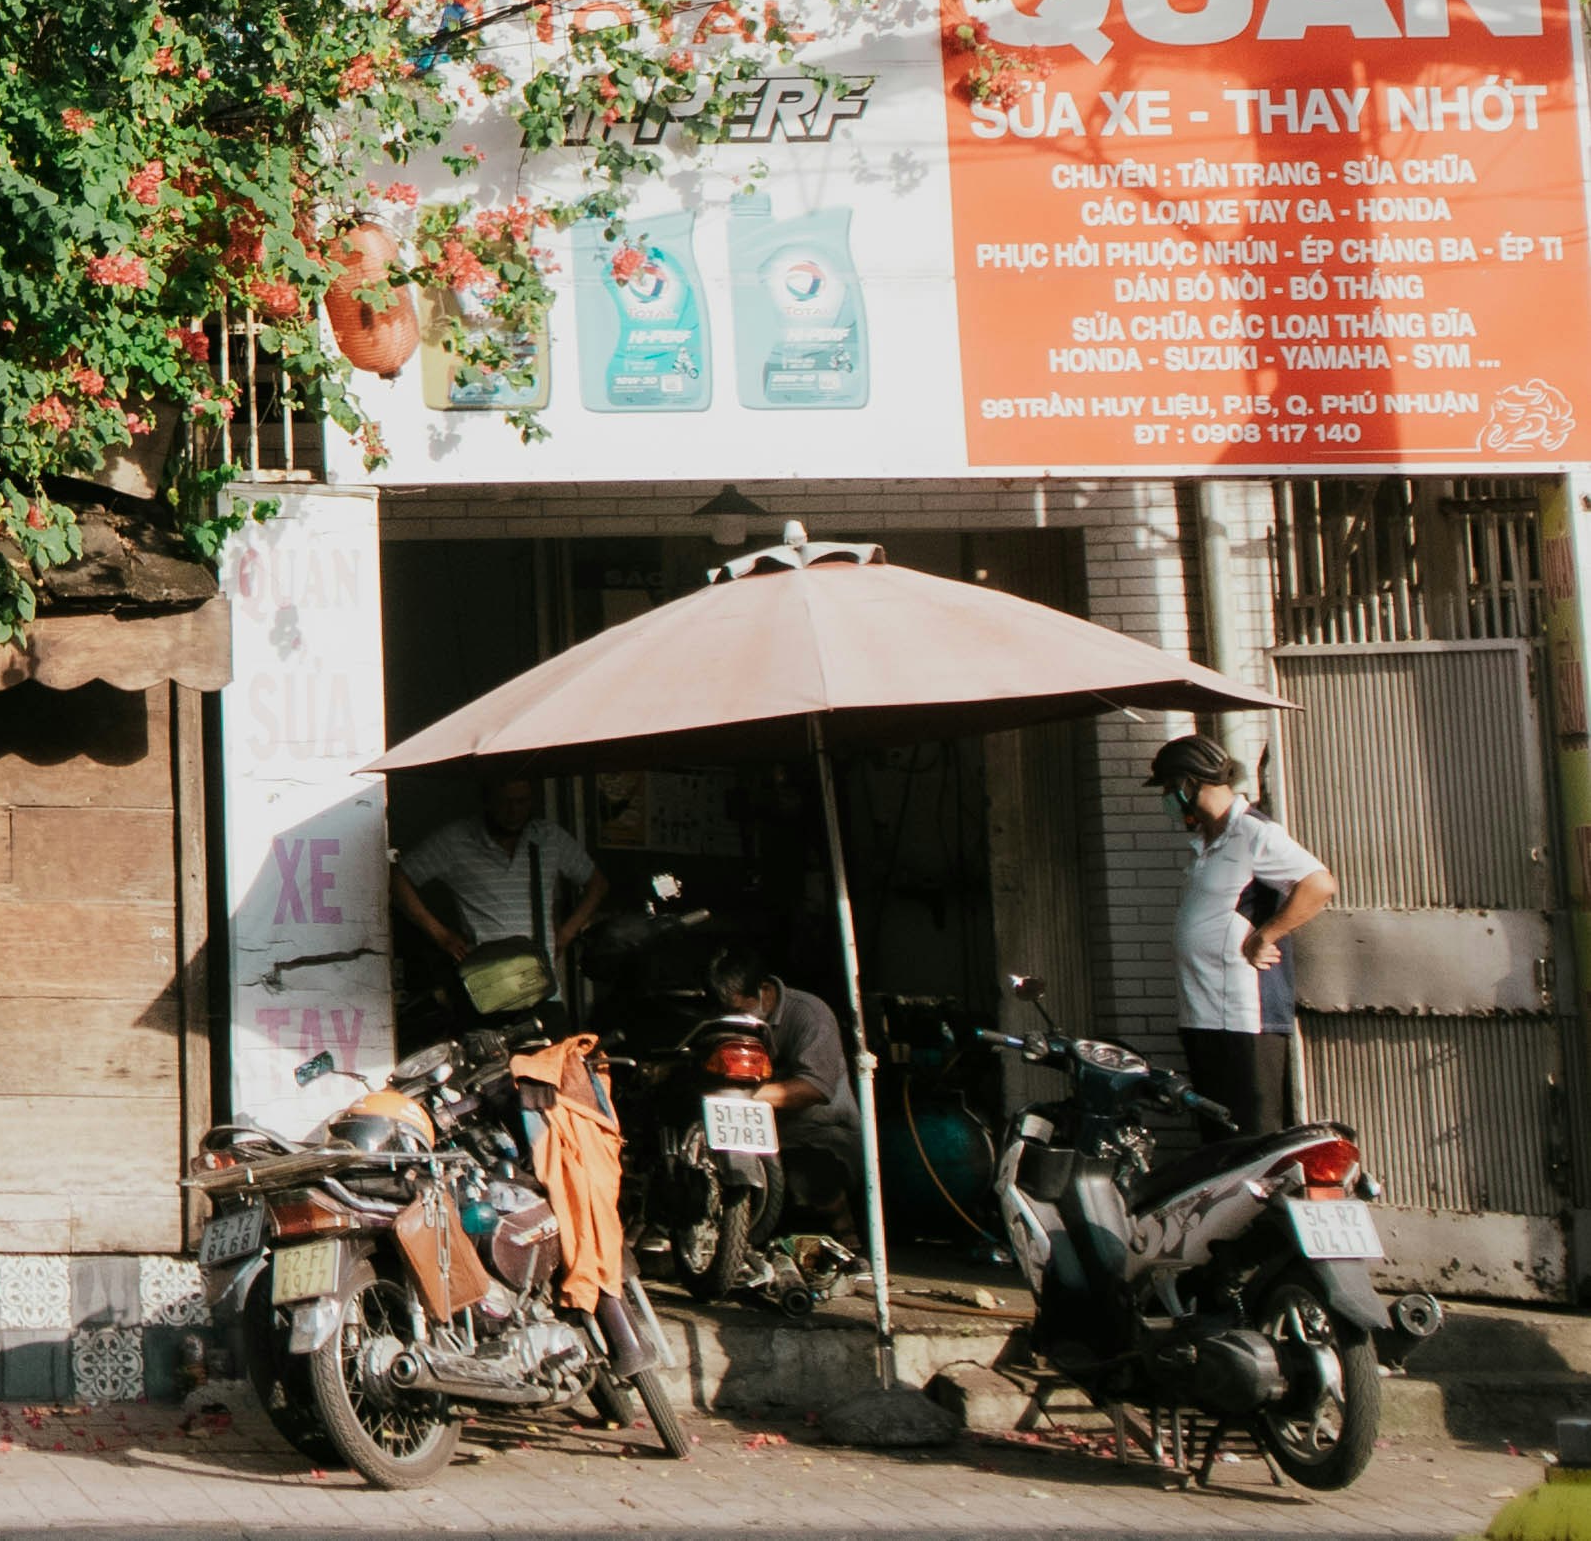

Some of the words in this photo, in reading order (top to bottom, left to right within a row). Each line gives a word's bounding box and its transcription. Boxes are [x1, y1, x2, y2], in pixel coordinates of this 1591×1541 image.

[1100, 90, 1173, 137] XE
[1221, 87, 1369, 135] THAY
[1385, 74, 1548, 133] NHỚT
[1050, 157, 1157, 190] CHUYÊN
[1174, 157, 1229, 188] TÂN
[1230, 161, 1320, 188] TRANG
[1343, 154, 1398, 185] SỬA
[1080, 195, 1137, 227] CÁC
[1141, 200, 1201, 229] LOẠI
[1205, 199, 1240, 225] XE
[1242, 199, 1290, 223] TAY
[1296, 199, 1334, 223] GA
[1357, 196, 1453, 223] HONDA
[975, 242, 1049, 273] PHỤC
[1104, 237, 1198, 274] PHUỘC
[1202, 236, 1277, 265] NHÚN
[1301, 235, 1334, 264] ÉP
[1438, 237, 1478, 263] BA
[1497, 230, 1534, 262] ÉP
[1113, 271, 1170, 304] DÁN
[1070, 310, 1127, 343] SỬA
[1208, 309, 1264, 341] CÁC
[1271, 314, 1329, 345] LOẠI
[1429, 306, 1477, 338] ĐĨA
[1047, 346, 1144, 374] HONDA
[1162, 345, 1257, 373] SUZUKI
[1281, 345, 1390, 369] YAMAHA
[1411, 343, 1472, 370] SYM
[1089, 395, 1146, 418] HUY
[1286, 395, 1313, 415] Q.
[1321, 391, 1376, 414] PHÚ
[1384, 389, 1480, 418] NHUẬN
[1133, 423, 1171, 445] ĐT
[1190, 423, 1260, 444] 0908
[1268, 424, 1307, 442] 117
[1314, 423, 1361, 443] 140
[270, 837, 344, 925] XE
[255, 1008, 365, 1096] TAY
[714, 1104, 764, 1125] 51-F5
[717, 1125, 768, 1147] 5783
